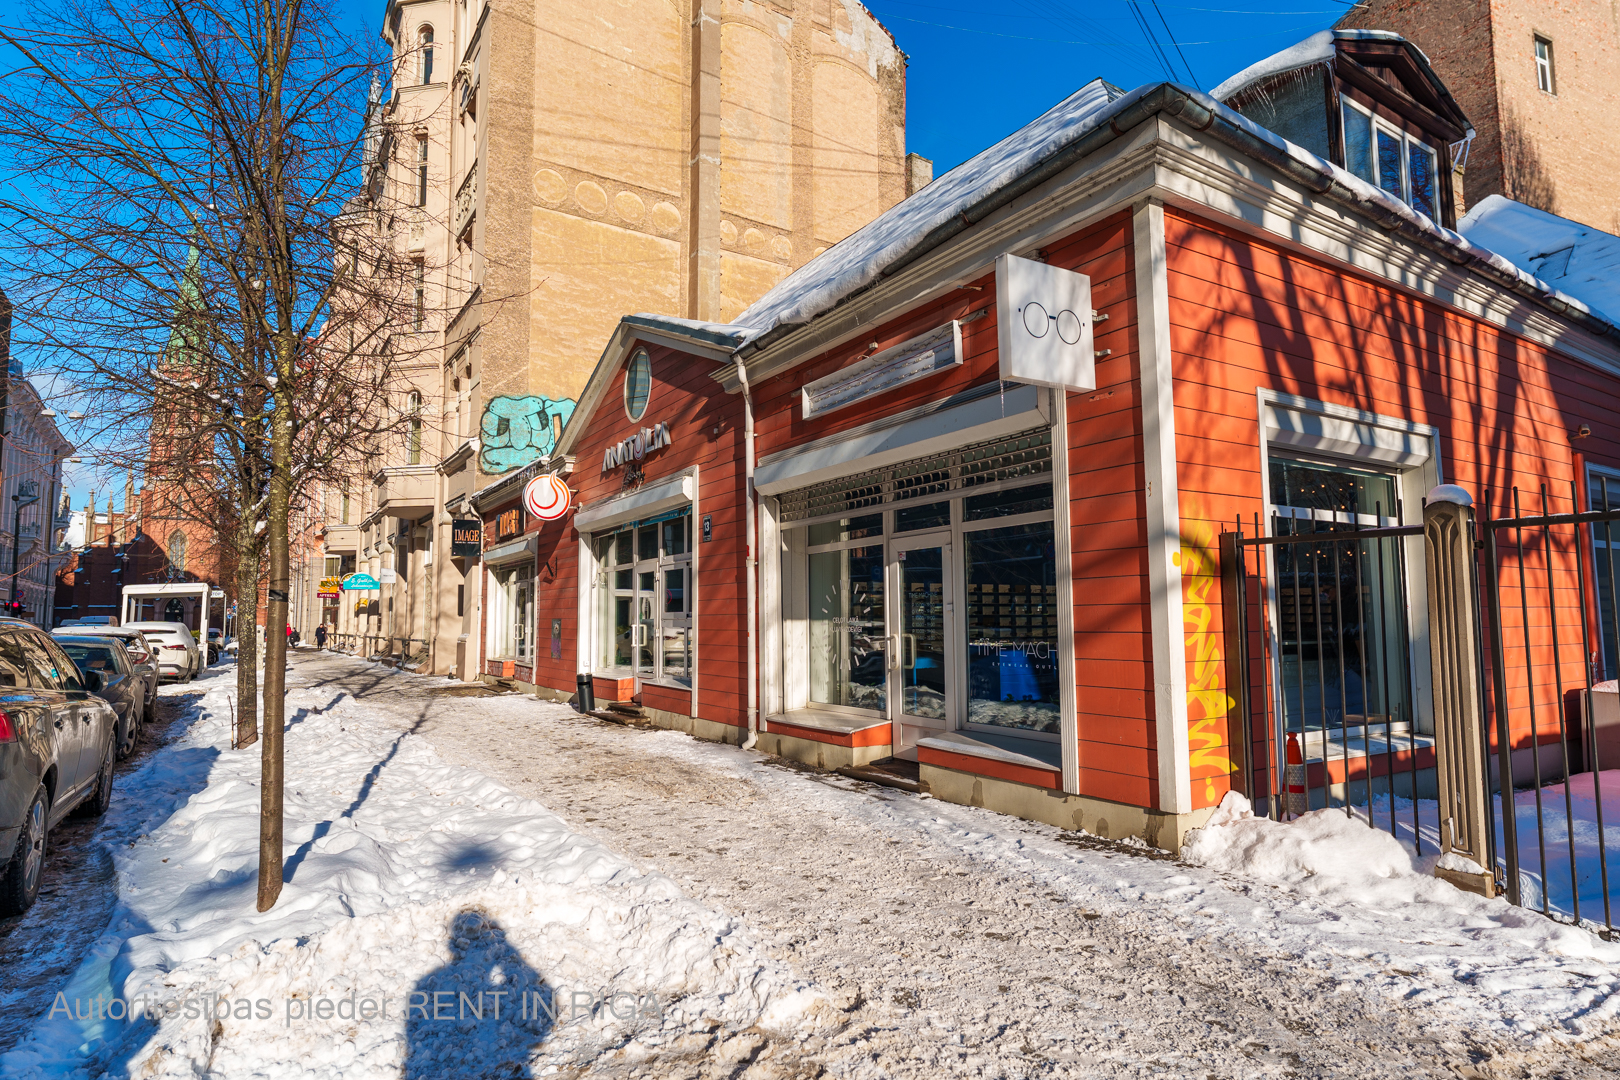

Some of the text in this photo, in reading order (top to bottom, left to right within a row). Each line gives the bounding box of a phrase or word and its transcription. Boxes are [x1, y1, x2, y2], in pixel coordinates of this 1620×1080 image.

[704, 521, 710, 532] 13
[454, 528, 480, 542] IMAGE
[977, 639, 1008, 657] TIME
